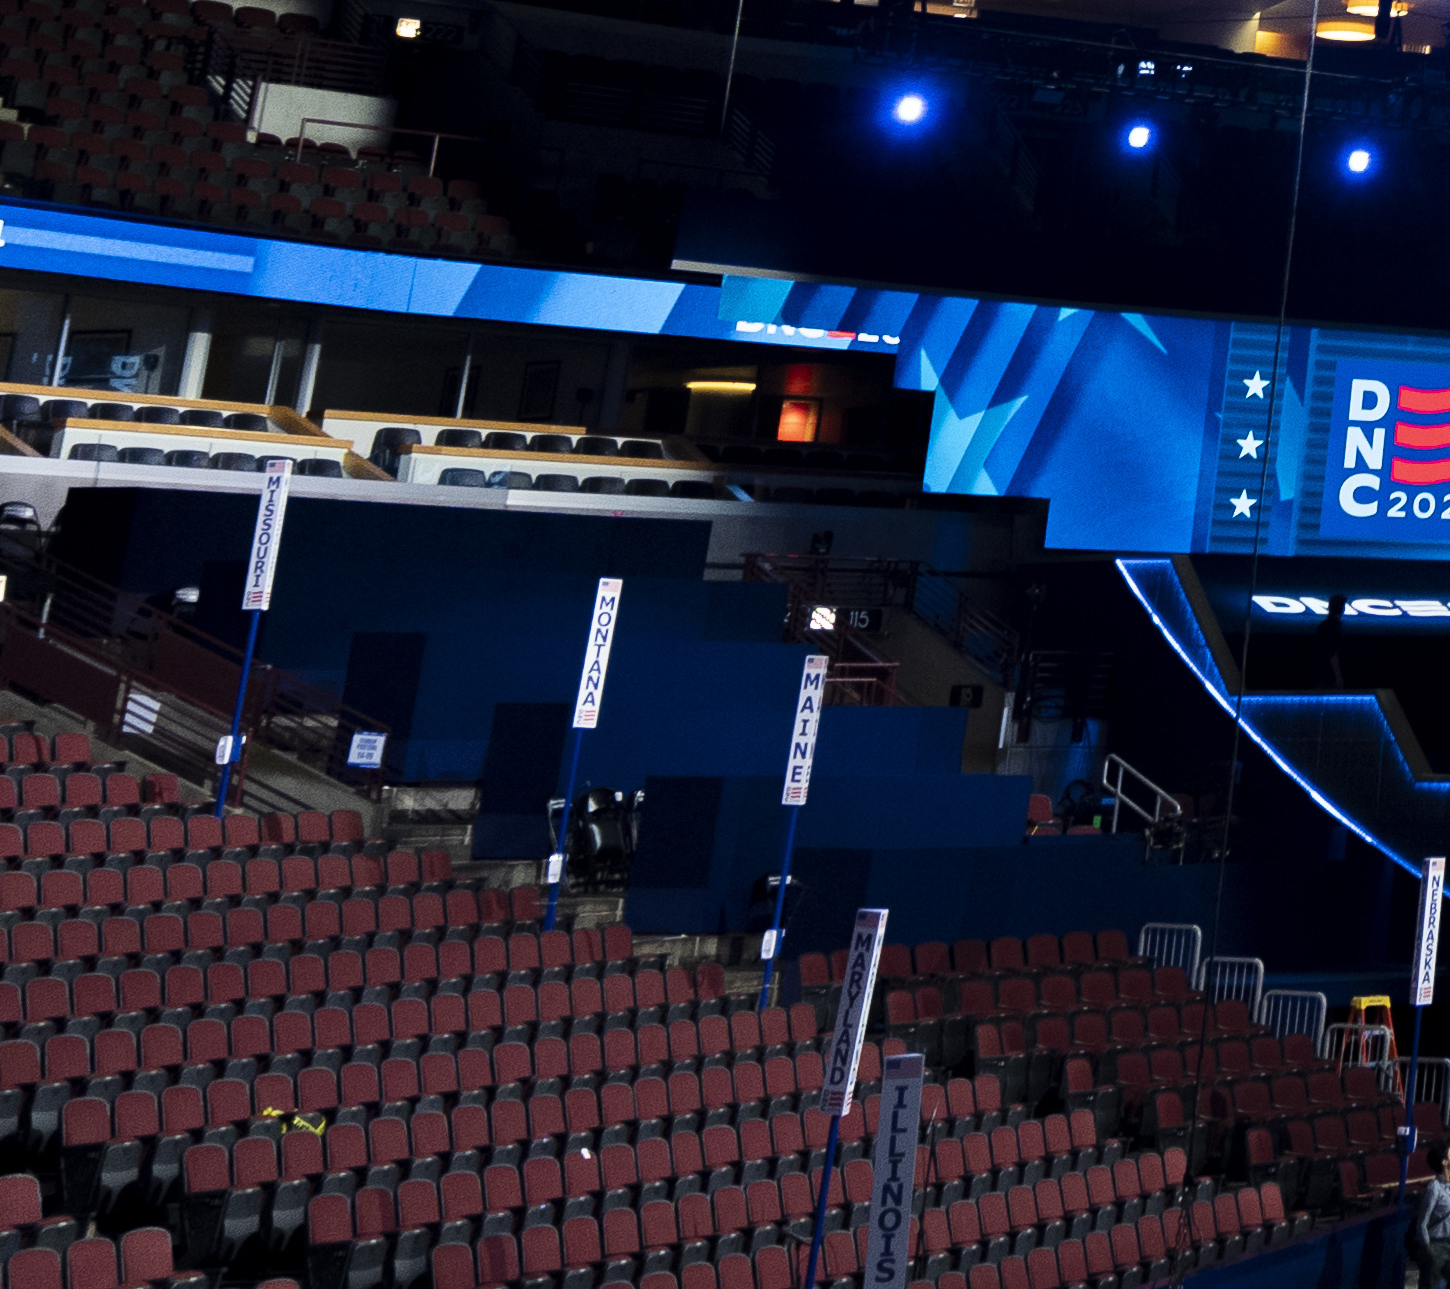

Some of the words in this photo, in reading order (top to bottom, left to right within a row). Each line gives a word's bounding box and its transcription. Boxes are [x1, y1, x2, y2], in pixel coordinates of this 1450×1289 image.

[1337, 377, 1392, 518] DNC
[252, 476, 281, 588] MISSOURI
[582, 596, 616, 706] MONTANA
[850, 610, 870, 629] 115
[791, 673, 821, 783] MAINE
[1422, 875, 1441, 985] NEBRASKA
[829, 933, 873, 1085] MARYLAND
[875, 1084, 909, 1283] ILLINOIS
